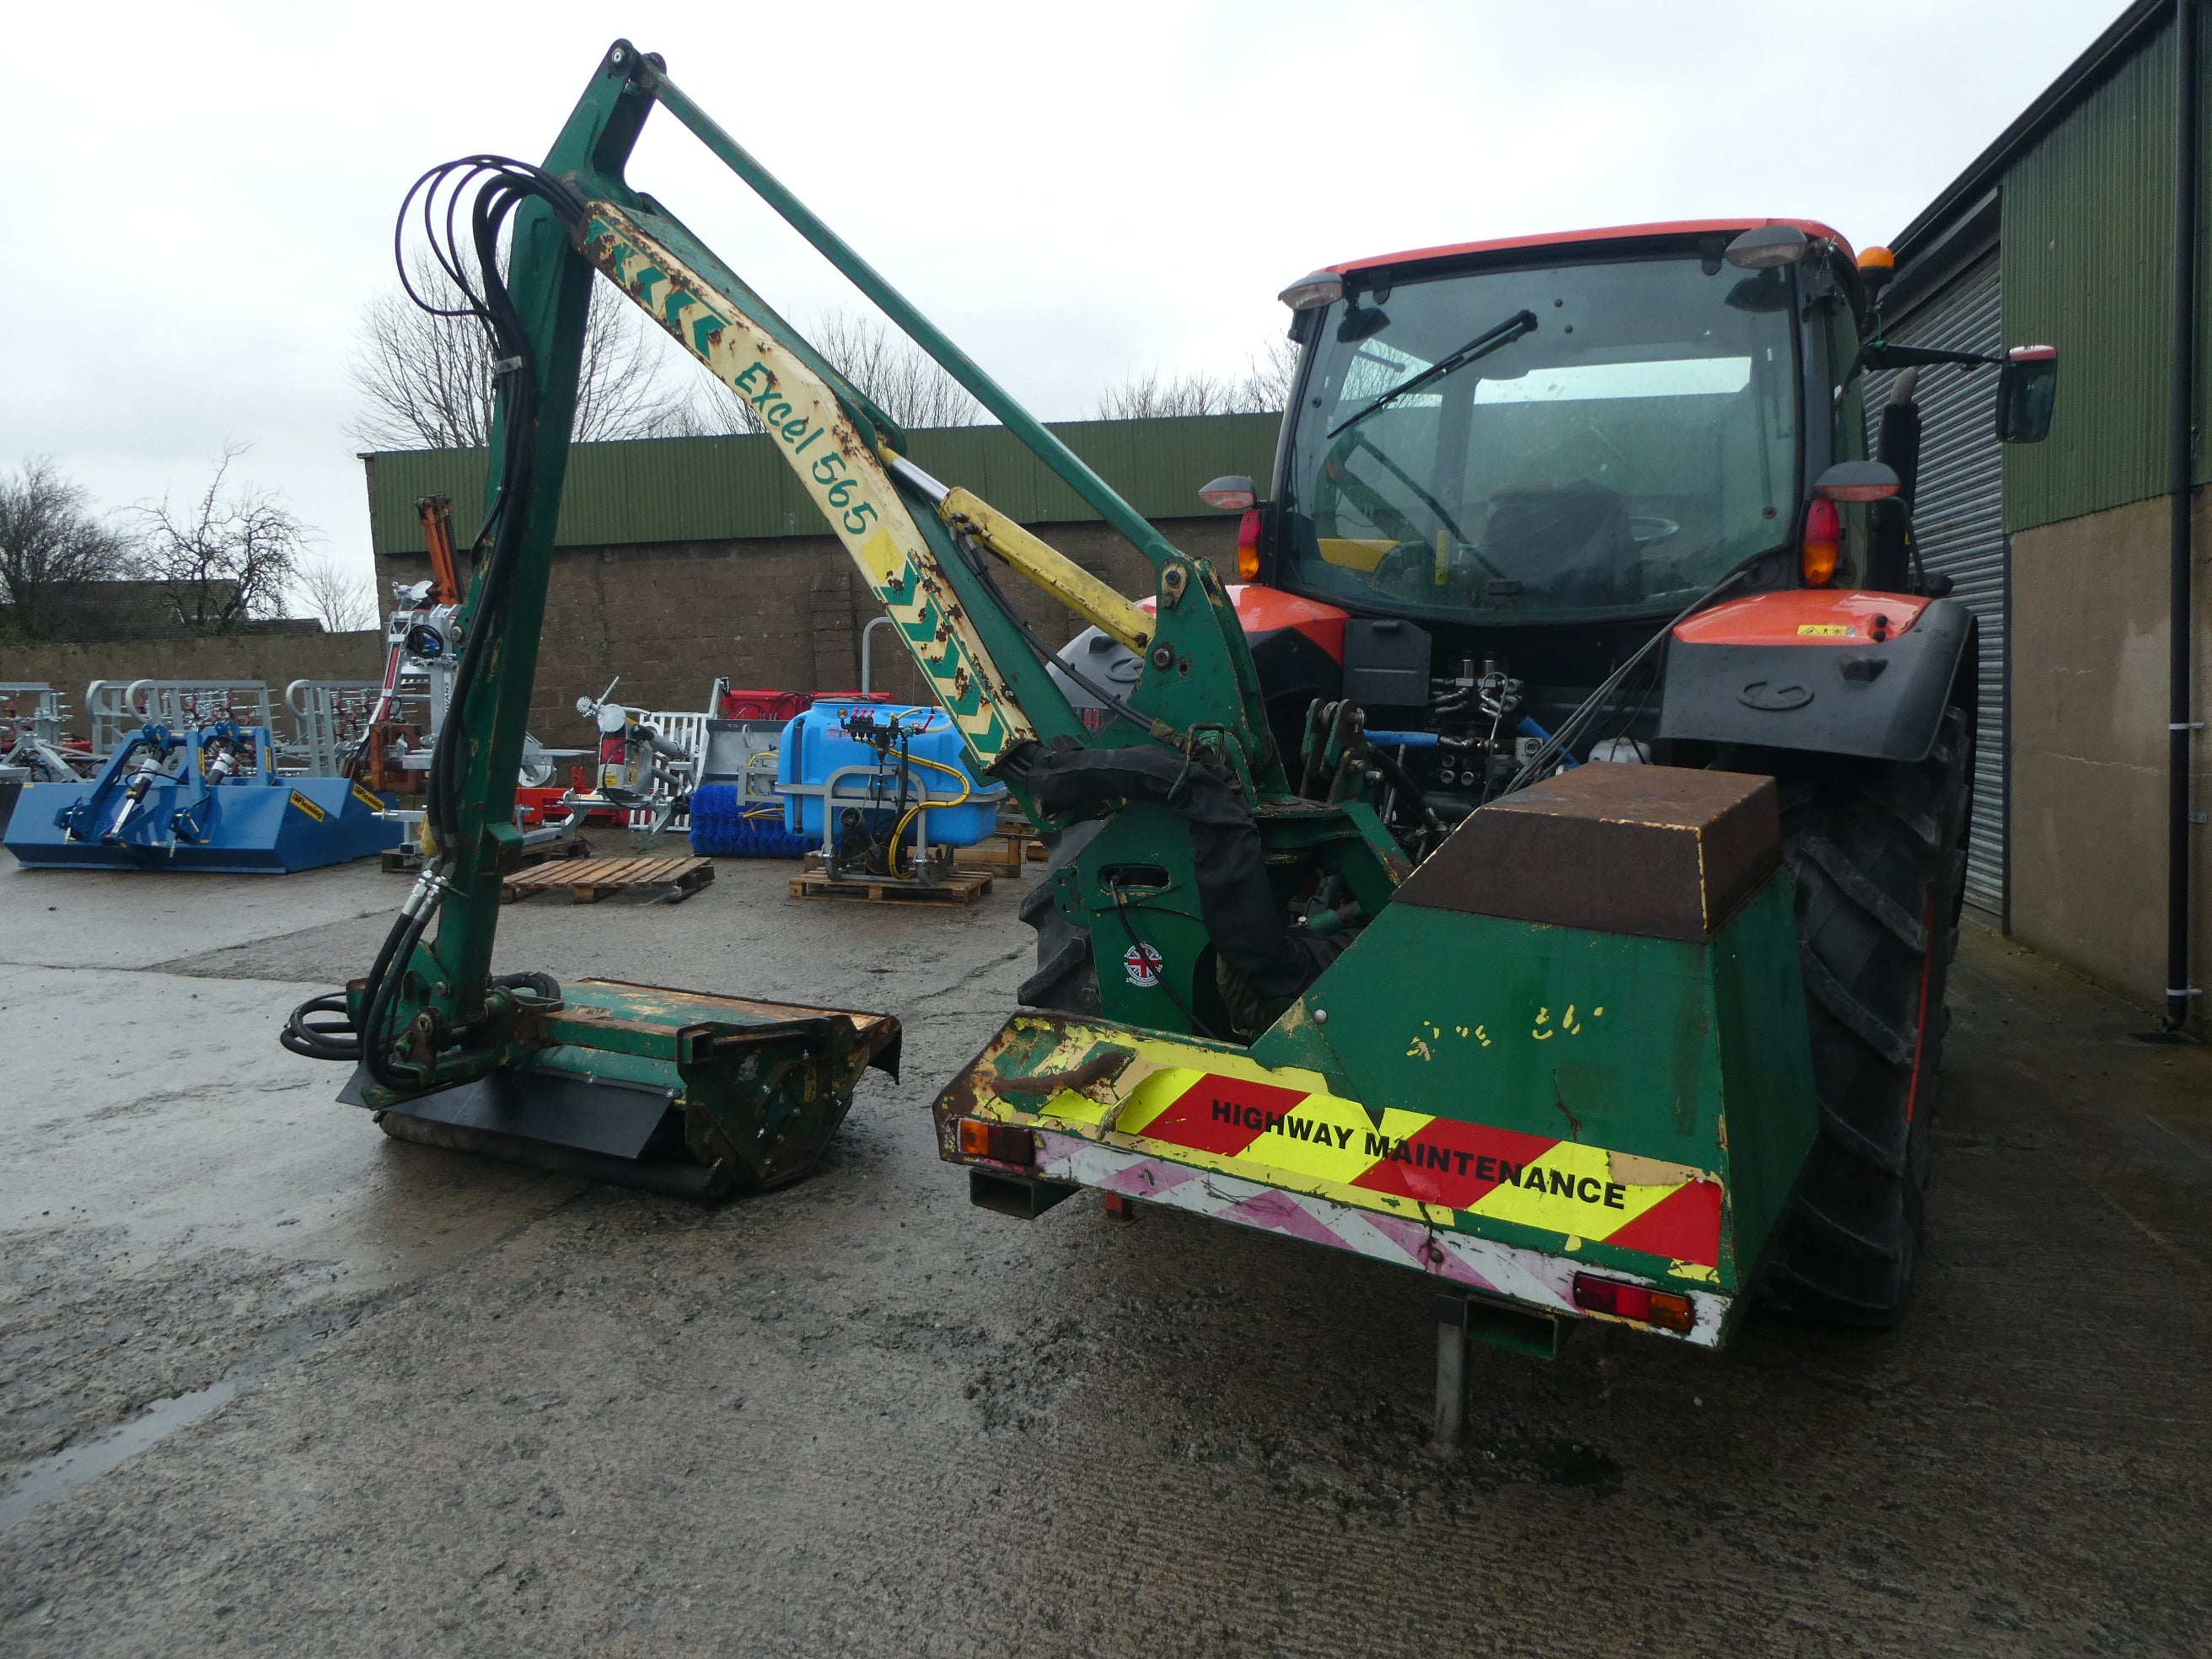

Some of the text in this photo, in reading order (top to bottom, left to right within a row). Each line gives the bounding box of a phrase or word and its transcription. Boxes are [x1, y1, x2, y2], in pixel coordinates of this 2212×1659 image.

[734, 361, 878, 535] Excel 565
[298, 795, 323, 820] Fleming
[360, 789, 384, 810] Fleming
[1211, 1098, 1626, 1211] HIGHWAY MAINTENANCE
